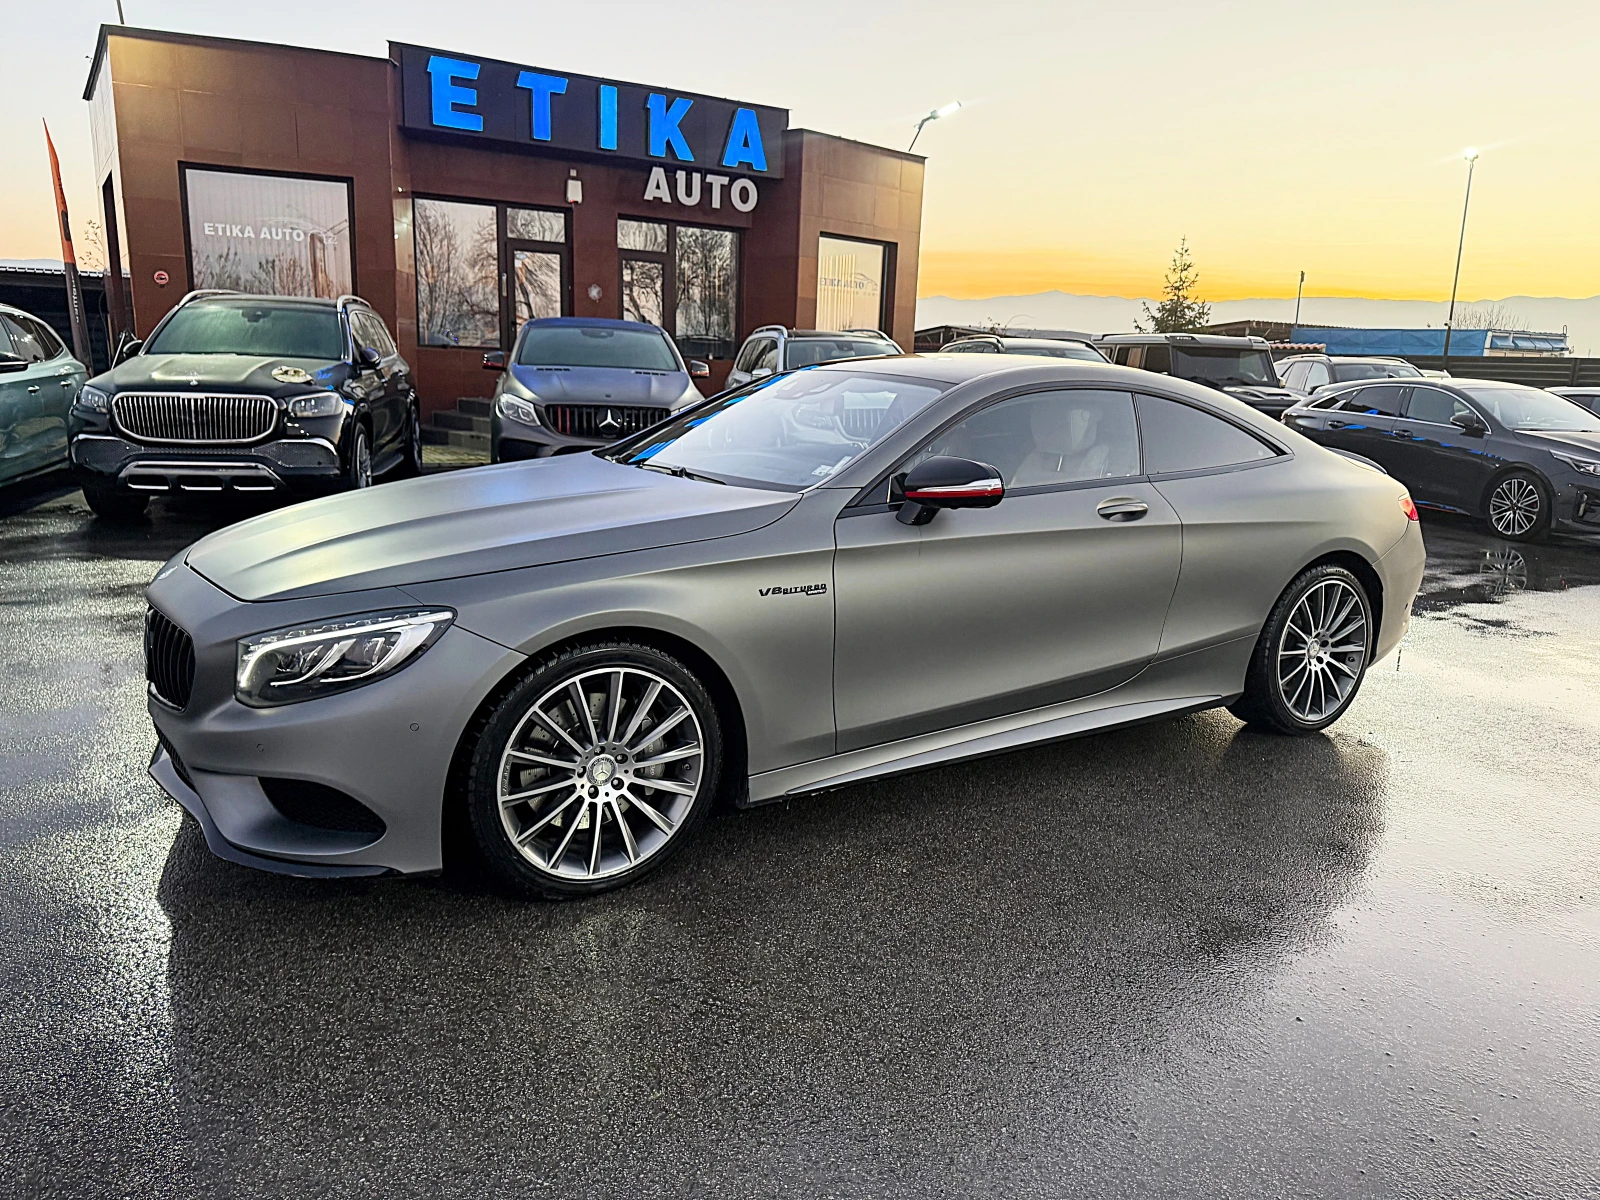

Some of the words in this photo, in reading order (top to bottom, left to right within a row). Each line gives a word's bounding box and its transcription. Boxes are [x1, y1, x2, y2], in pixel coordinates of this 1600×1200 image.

[427, 55, 768, 171] ETIKA
[644, 166, 758, 212] AUTO
[203, 222, 255, 238] ETIKA
[260, 227, 305, 242] AUTO
